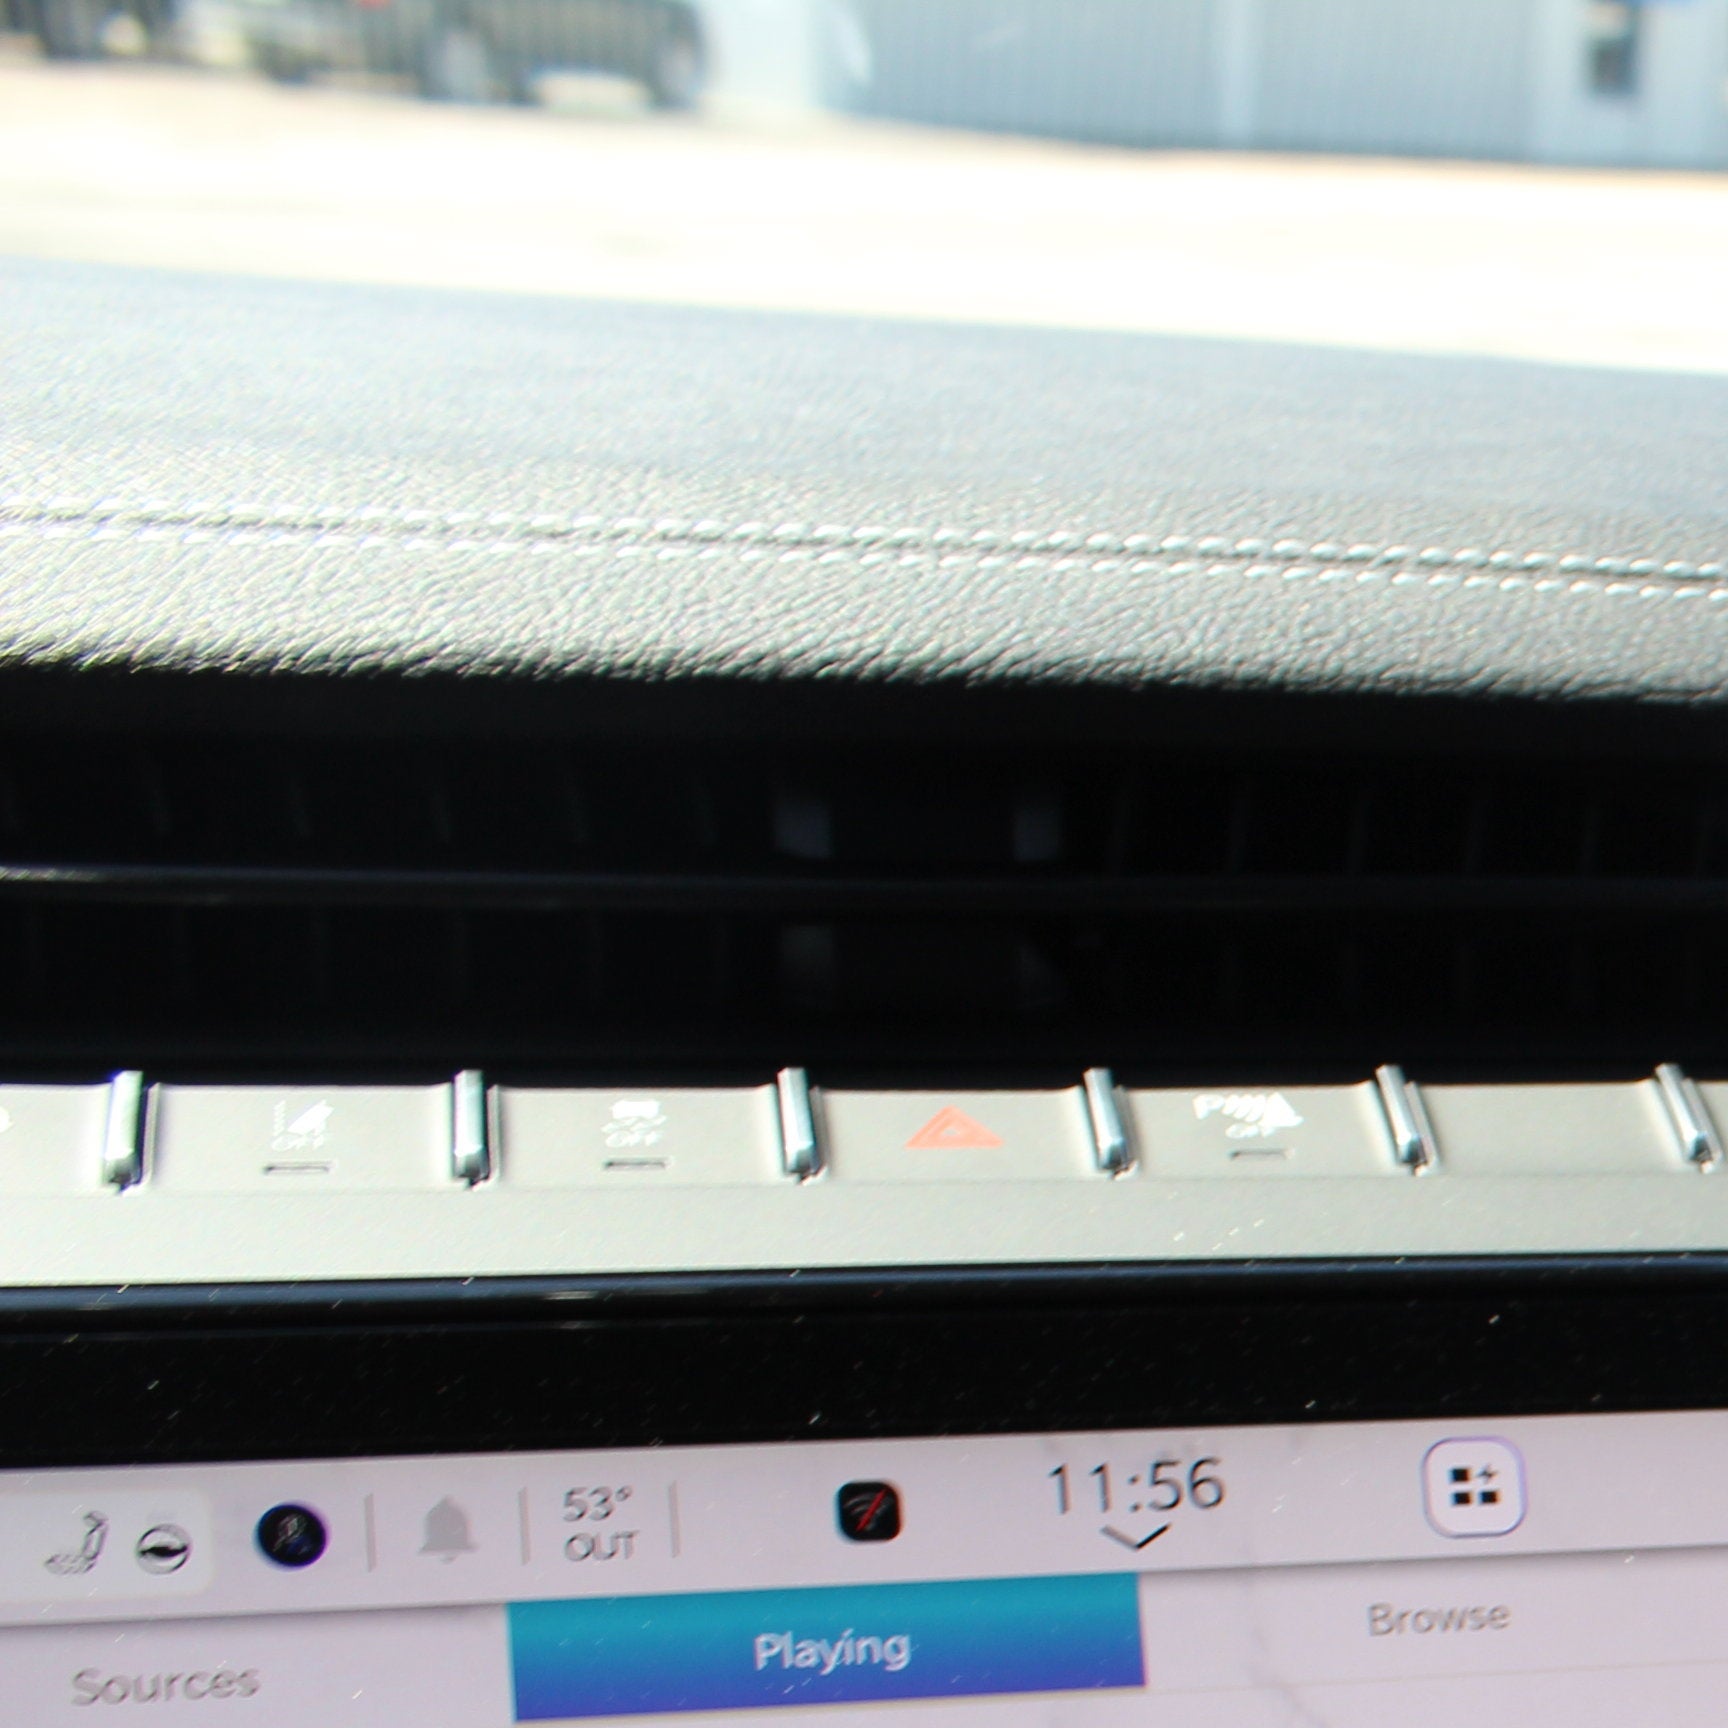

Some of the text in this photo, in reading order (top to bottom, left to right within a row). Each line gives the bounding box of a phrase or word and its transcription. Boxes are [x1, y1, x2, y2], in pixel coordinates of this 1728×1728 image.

[1048, 1456, 1227, 1516] 11:56
[563, 1531, 641, 1563] OUT
[1367, 1600, 1512, 1638] Browse
[754, 1625, 912, 1673] Playing
[72, 1663, 261, 1707] Sources
